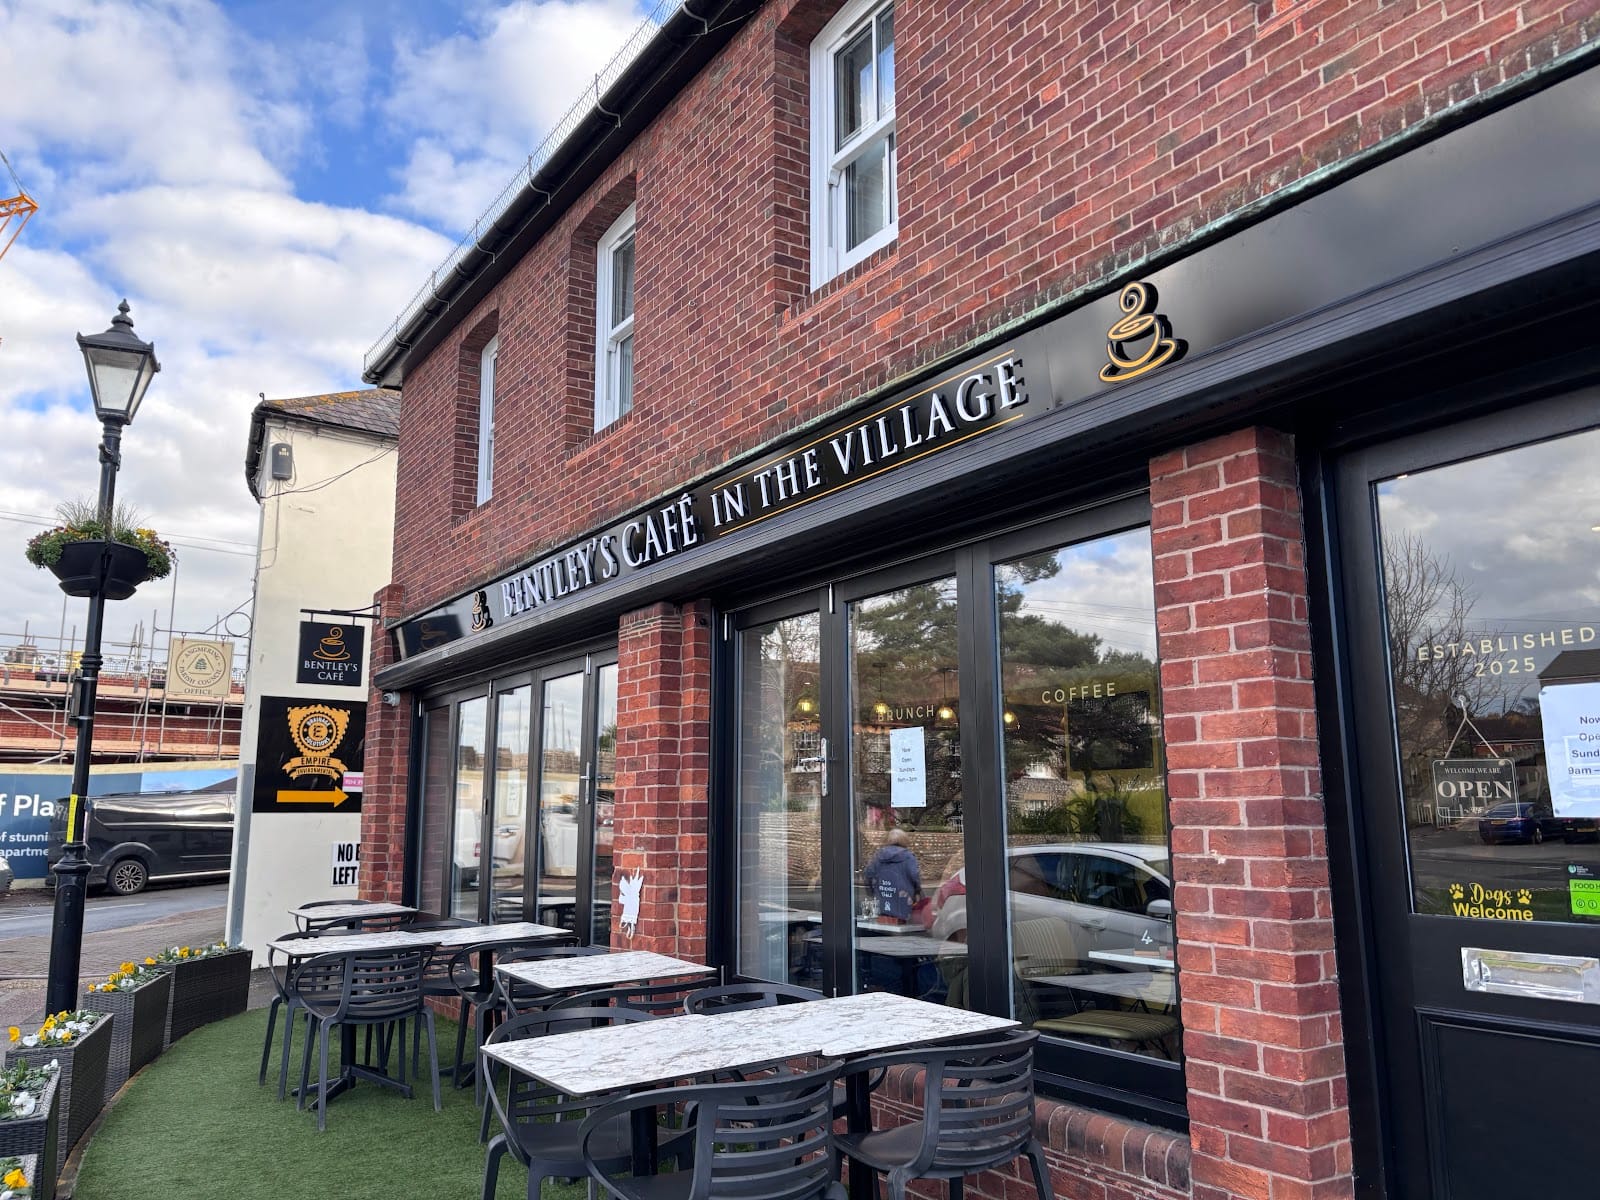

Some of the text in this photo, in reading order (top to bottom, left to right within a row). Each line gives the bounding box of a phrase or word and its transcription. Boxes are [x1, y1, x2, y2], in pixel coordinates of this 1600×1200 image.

[501, 356, 1022, 618] BENTLEY'S CAFÉ IN THE VILLAGE
[1417, 626, 1596, 661] ESTABLISHED
[184, 646, 221, 661] ANGMERING
[179, 666, 221, 685] PARISH COUNCIL
[304, 660, 358, 672] BENTLEY'S
[1474, 656, 1536, 677] 2025
[317, 671, 345, 681] CAFÉ
[184, 687, 212, 695] OFFICE
[1041, 682, 1116, 704] COFFEE
[878, 704, 934, 722] BRUNCH
[300, 757, 332, 766] EMPIRE
[1571, 748, 1600, 759] Sund
[1438, 780, 1512, 799] OPEN
[337, 843, 353, 862] NO
[332, 866, 358, 885] LEFT
[1469, 882, 1513, 907] Dogs
[1453, 902, 1534, 921] Welcome
[1141, 929, 1153, 945] 4
